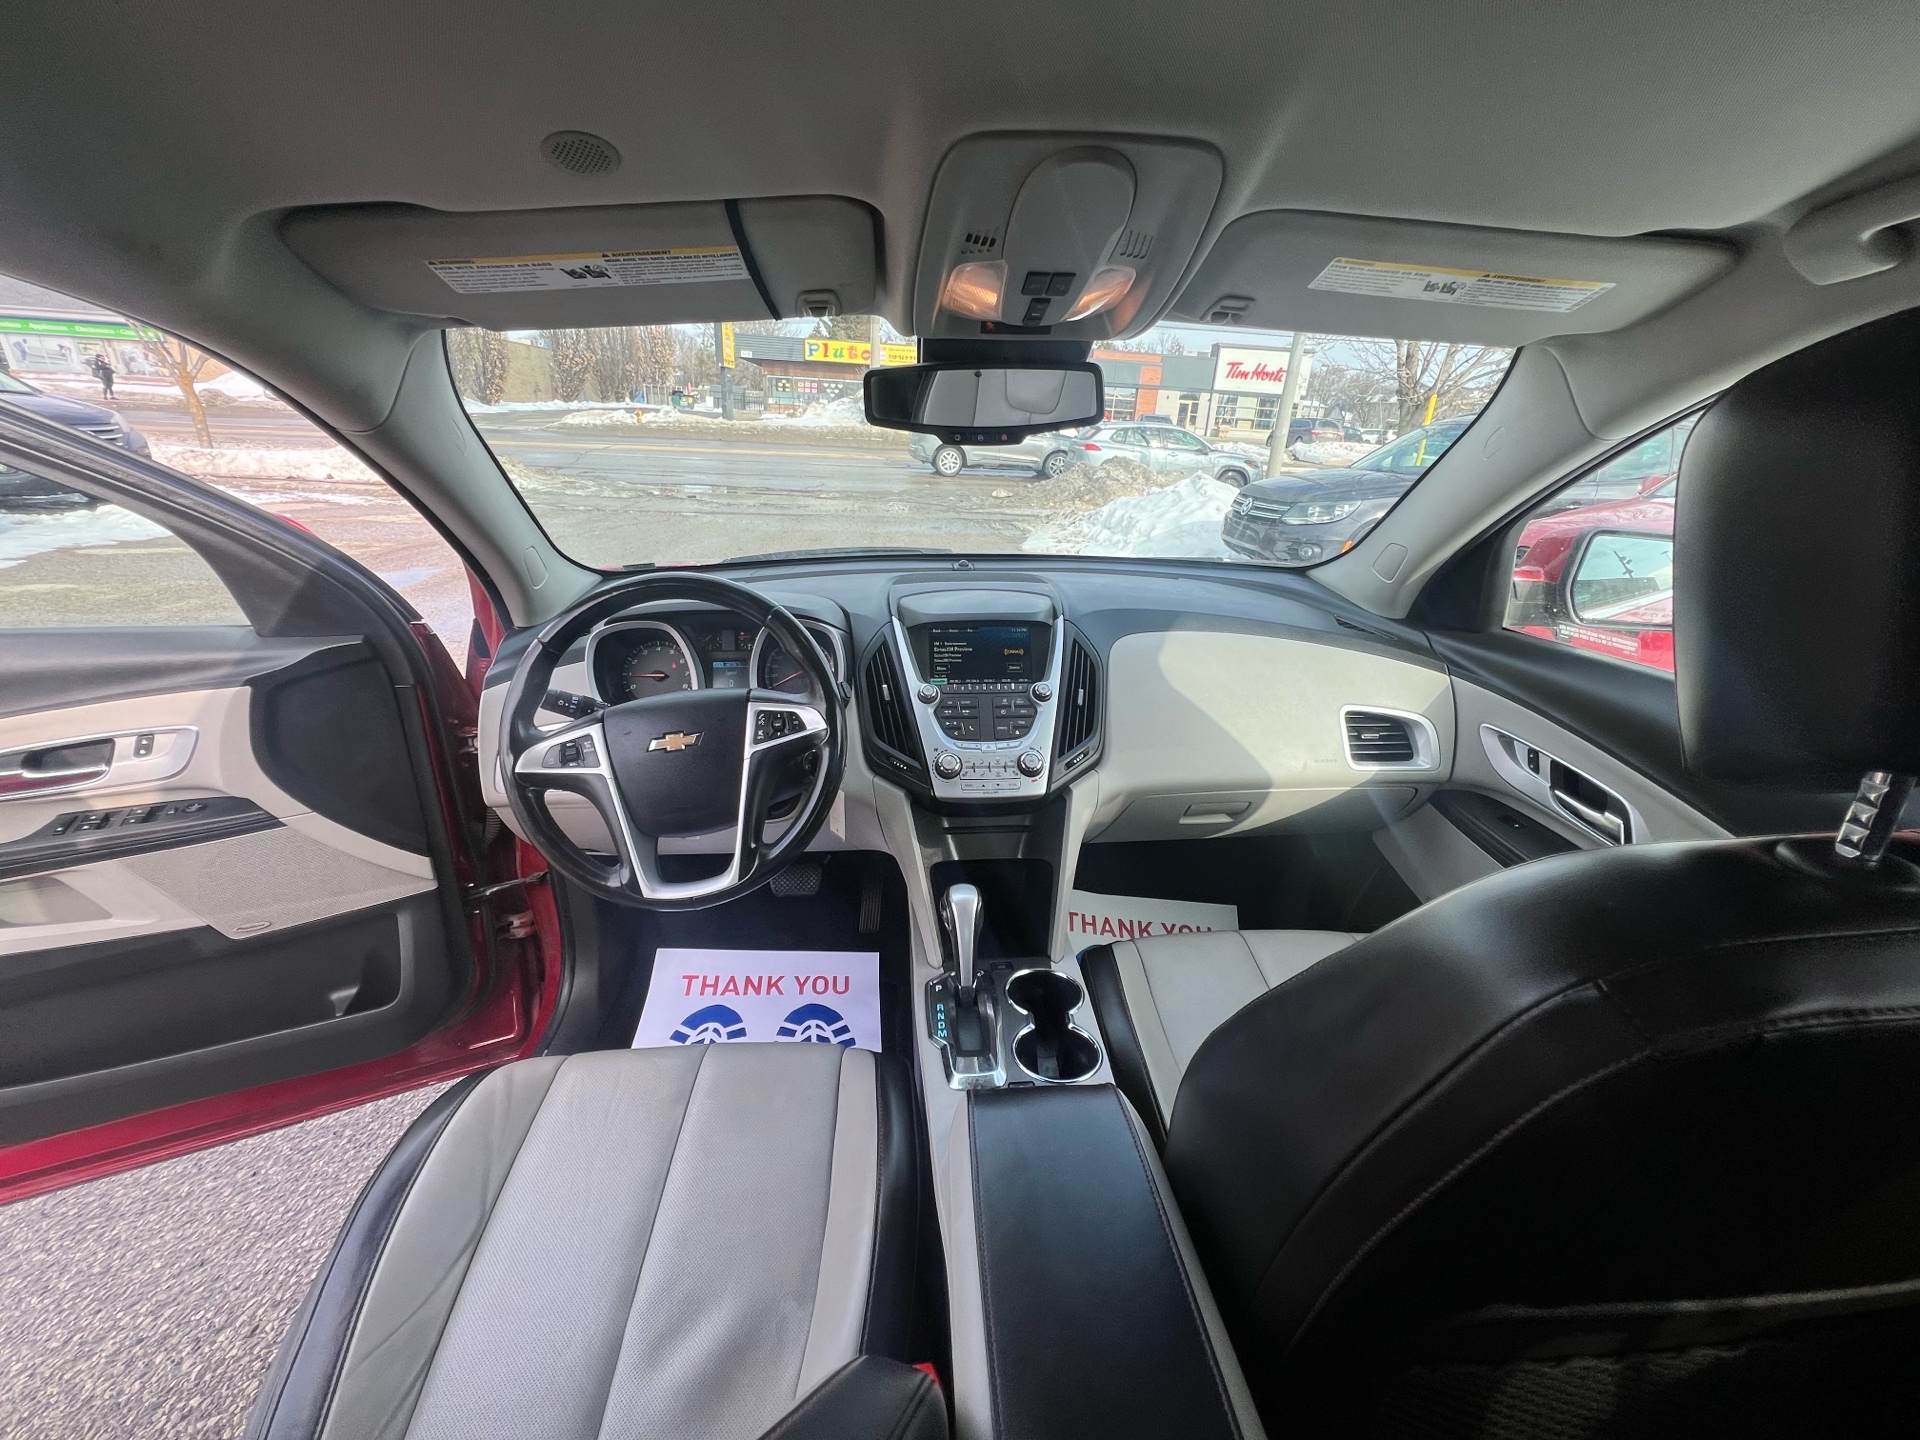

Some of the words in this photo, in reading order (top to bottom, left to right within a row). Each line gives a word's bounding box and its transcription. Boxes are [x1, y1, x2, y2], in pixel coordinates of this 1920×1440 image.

[807, 342, 871, 361] Pluto
[1225, 362, 1250, 380] Tim
[1068, 911, 1154, 939] THANK
[681, 974, 786, 997] THANK
[793, 974, 851, 996] YOU
[937, 1012, 945, 1020] N
[937, 1021, 946, 1029] D
[937, 1030, 948, 1038] M
